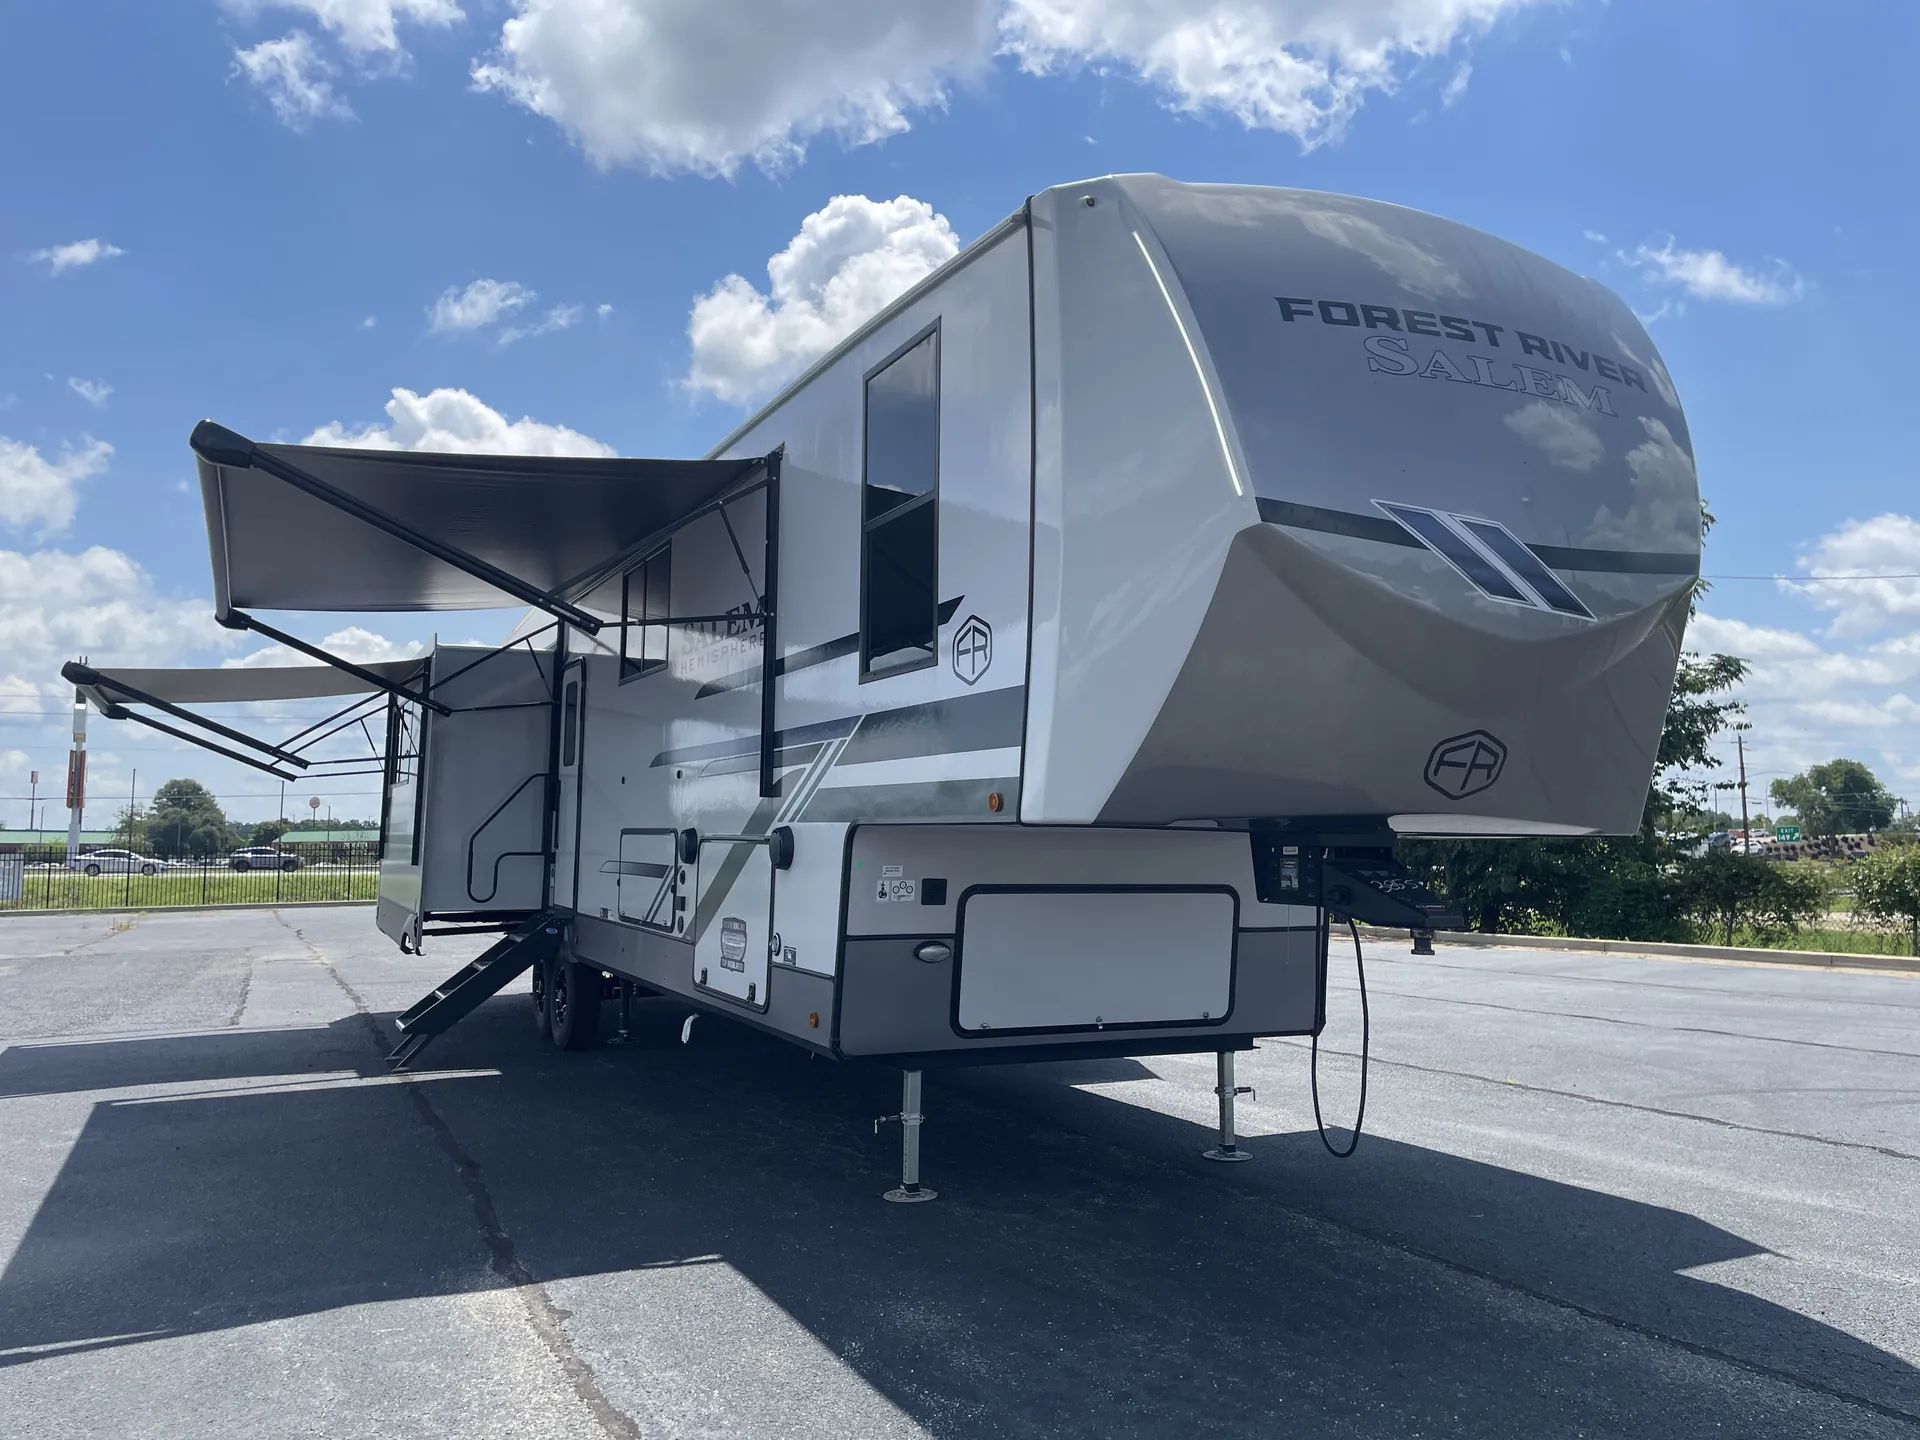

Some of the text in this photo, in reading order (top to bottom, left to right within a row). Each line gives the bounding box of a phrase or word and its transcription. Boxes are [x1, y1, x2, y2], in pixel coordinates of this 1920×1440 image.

[1273, 296, 1648, 394] FOREST RIVER
[1364, 335, 1619, 418] SALEM
